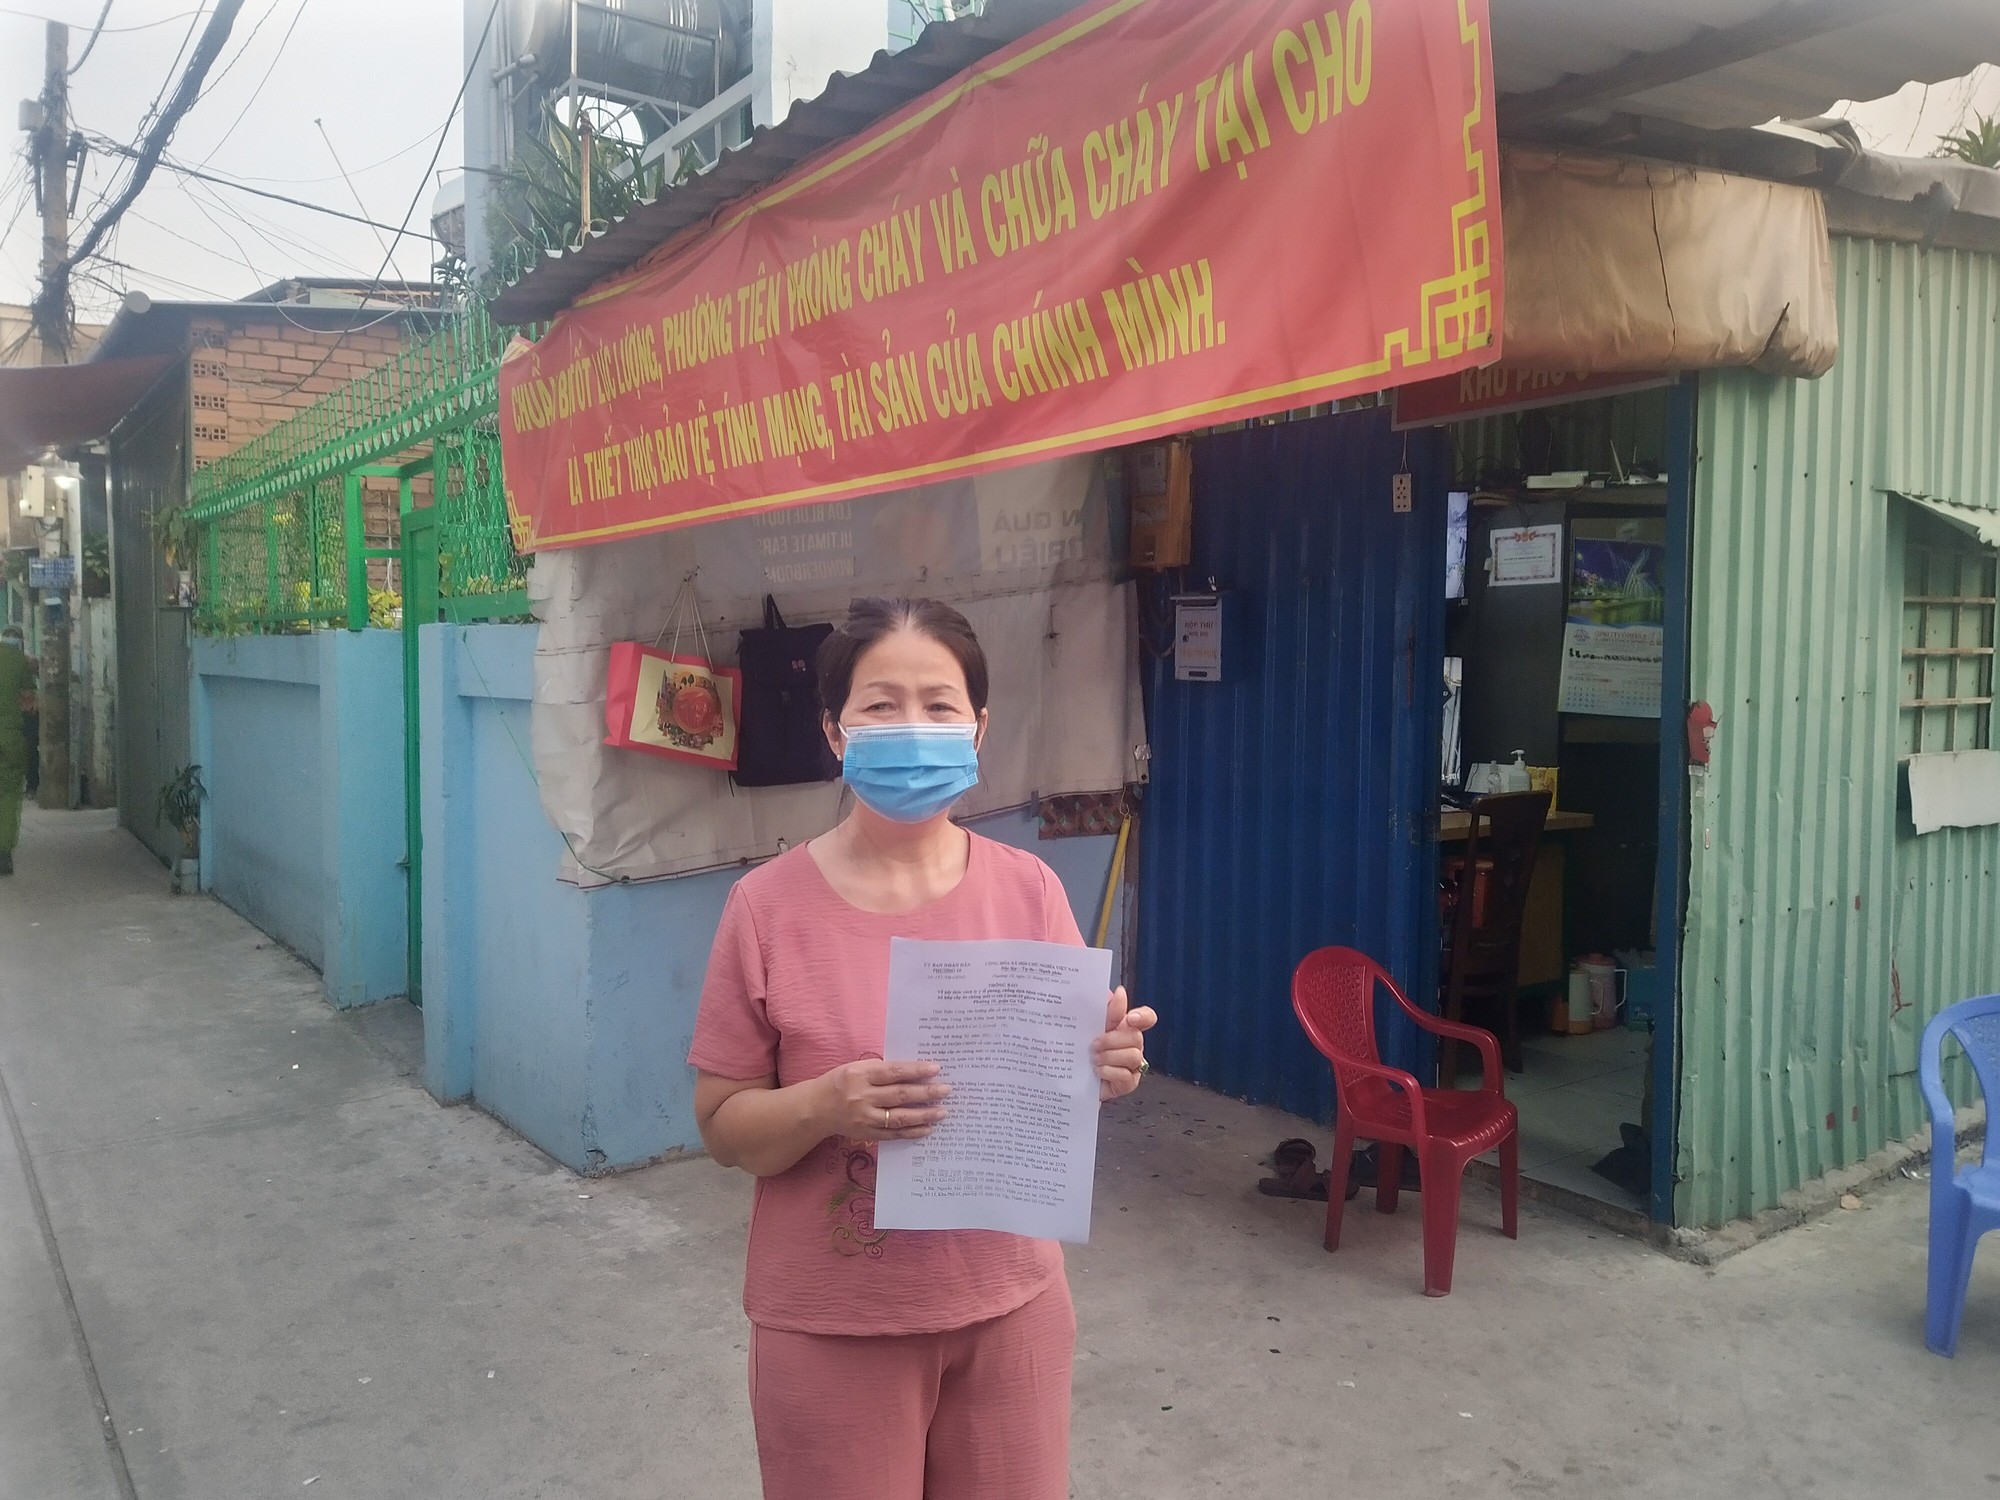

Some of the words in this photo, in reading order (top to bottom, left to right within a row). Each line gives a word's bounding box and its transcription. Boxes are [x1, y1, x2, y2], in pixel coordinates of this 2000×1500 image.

[662, 292, 734, 375] PHƯƠNG
[738, 261, 781, 356] TIỆN
[858, 194, 925, 302] CHÁY
[931, 167, 977, 275] VÀ
[981, 132, 1077, 258] CHỮA
[1082, 82, 1184, 220] CHÁY
[1195, 50, 1271, 180] TẠI
[568, 443, 583, 506] LÀ
[583, 425, 622, 502] THIẾT
[623, 424, 658, 500] THỰC
[654, 403, 689, 484] BẢO
[688, 399, 716, 486] VỆ
[712, 392, 766, 484] TÍNH
[763, 382, 836, 469] MẠNG,
[830, 352, 874, 440] TÀI
[869, 328, 926, 434] SẢN
[926, 308, 993, 419] CỦA
[991, 290, 1109, 402] CHÍNH
[1102, 256, 1226, 372] MÌNH.
